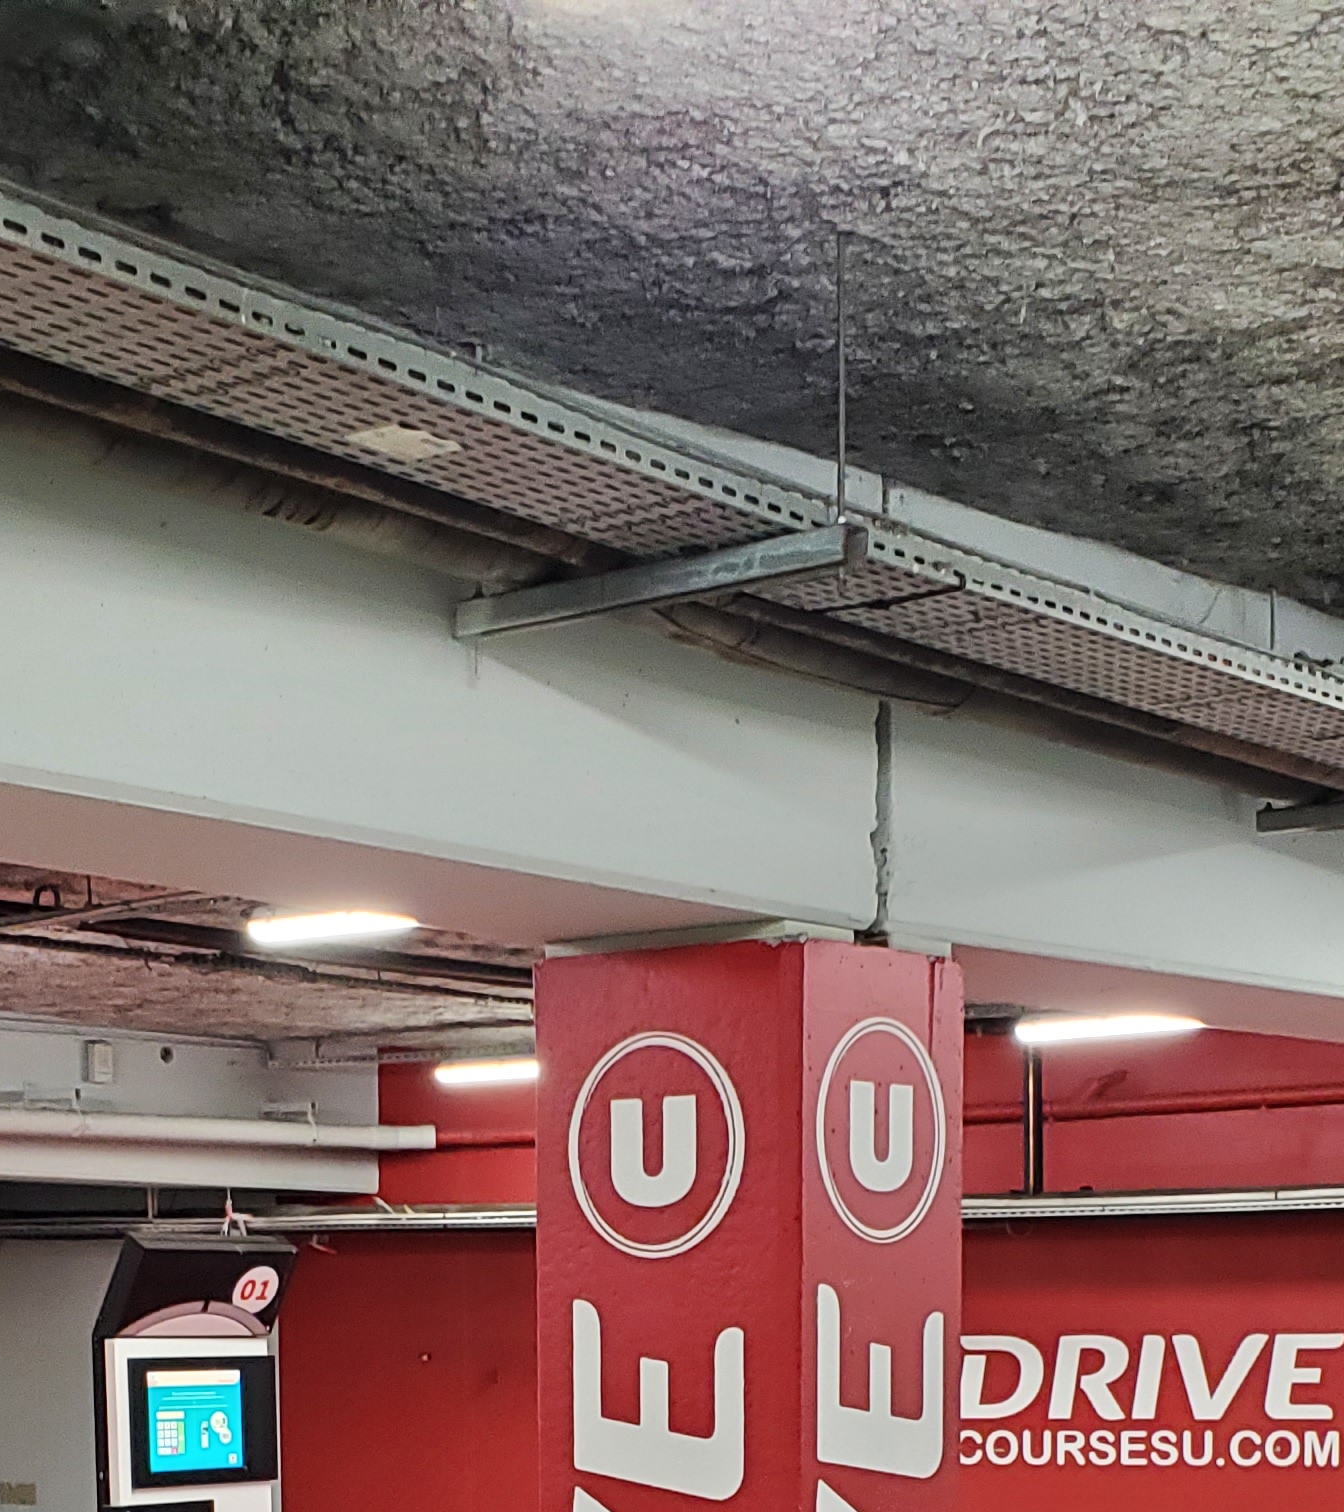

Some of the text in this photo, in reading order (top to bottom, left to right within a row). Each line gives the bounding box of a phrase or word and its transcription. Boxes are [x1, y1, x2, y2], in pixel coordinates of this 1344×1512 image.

[610, 1095, 697, 1208] U
[849, 1080, 914, 1192] U
[239, 1279, 270, 1301] 01
[960, 1429, 1341, 1467] COURSESU.COM
